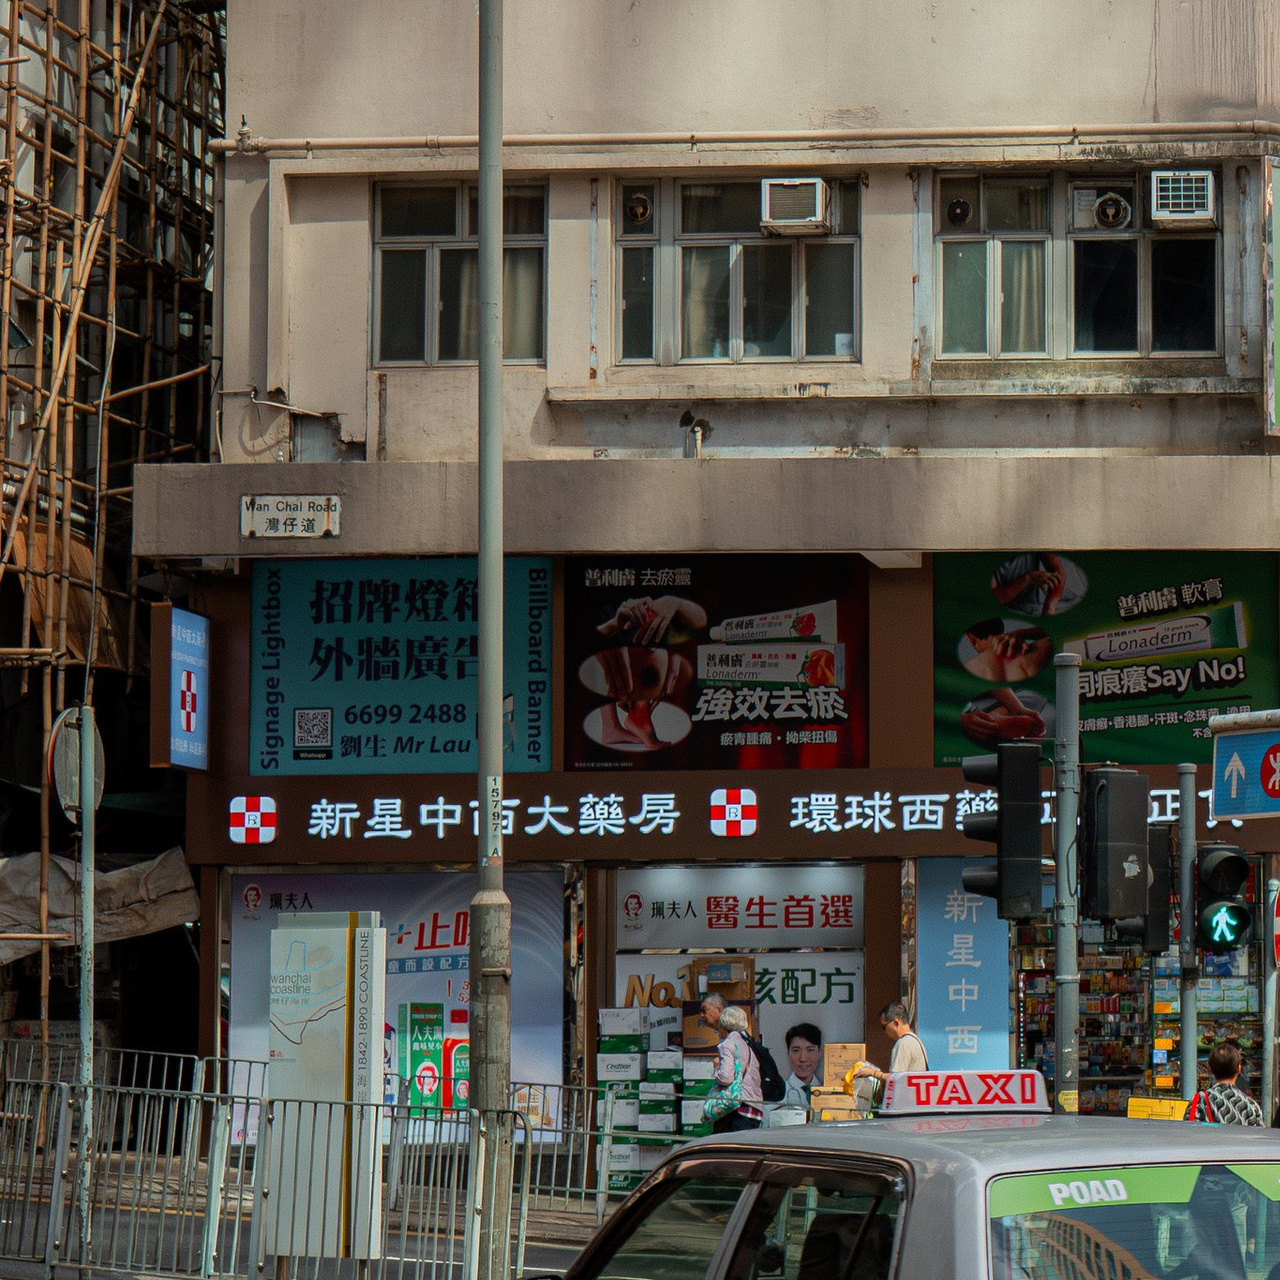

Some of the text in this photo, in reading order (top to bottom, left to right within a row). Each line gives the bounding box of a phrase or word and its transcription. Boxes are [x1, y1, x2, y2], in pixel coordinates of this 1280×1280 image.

[245, 501, 337, 512] Wan Chai Road
[265, 517, 316, 533] 灣仔道
[1109, 631, 1192, 653] Lonaderm
[261, 568, 285, 770] Signage Lightbox
[527, 568, 548, 763] Billboard Banner
[1198, 656, 1246, 683] No!
[344, 703, 467, 725] 6699 2488
[340, 734, 471, 758] 劉生 Mr Lau
[706, 894, 854, 930] 醫生首選
[270, 972, 312, 984] wanchai
[359, 931, 370, 1005] COASTLINE
[270, 984, 311, 995] coastline
[358, 1007, 369, 1071] 1842-1890
[907, 1074, 1036, 1106] TAXI
[1048, 1179, 1128, 1206] POAD
